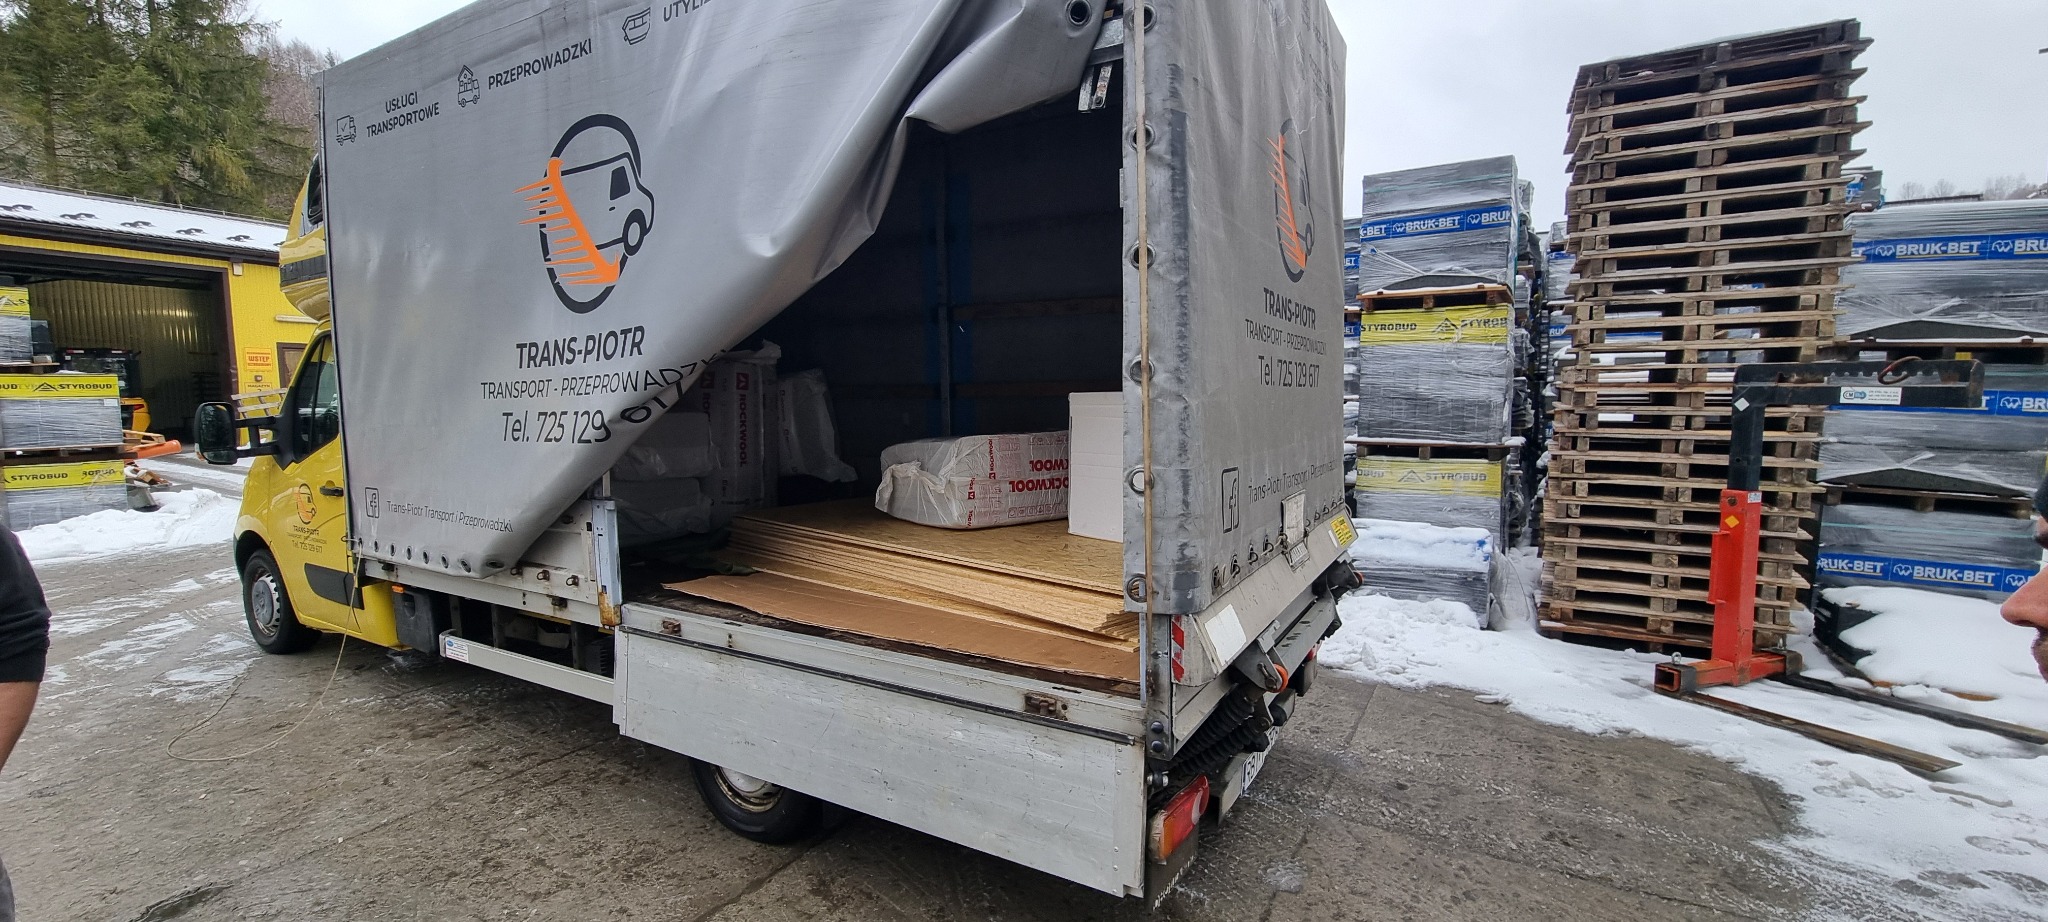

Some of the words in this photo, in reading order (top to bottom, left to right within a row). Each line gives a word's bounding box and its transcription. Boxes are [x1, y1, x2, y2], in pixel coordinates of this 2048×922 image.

[664, 0, 711, 22] UTYL
[488, 38, 592, 90] PRZEPROWADZKI
[385, 92, 418, 114] USŁUGI
[366, 102, 440, 138] TRANSPORTOWE
[1406, 216, 1461, 232] BRUK-BET
[1896, 241, 1981, 256] BRUK-BET
[1264, 287, 1316, 331] TRANS-PIOTR
[1245, 318, 1282, 347] TRANSPORT
[1360, 322, 1417, 332] STYROBUD
[516, 325, 645, 369] TRANS-PIOTR
[481, 378, 552, 400] TRANSPORT
[560, 348, 726, 397] PRZEPROWADZ
[1258, 355, 1275, 386] Tel.
[1277, 359, 1293, 387] 725
[1295, 361, 1306, 388] 129
[1309, 364, 1319, 388] 617
[502, 410, 530, 443] Tel.
[535, 410, 568, 443] 725
[571, 410, 611, 444] 129
[738, 393, 748, 468] ROCKWOOL
[11, 472, 68, 481] STYROBUD
[1425, 472, 1487, 481] STYROBUD
[386, 500, 423, 517] Trans-Piotr
[424, 506, 455, 523] Transport
[459, 511, 514, 534] Przeprowadzki
[1913, 565, 1996, 584] BRUK-BET
